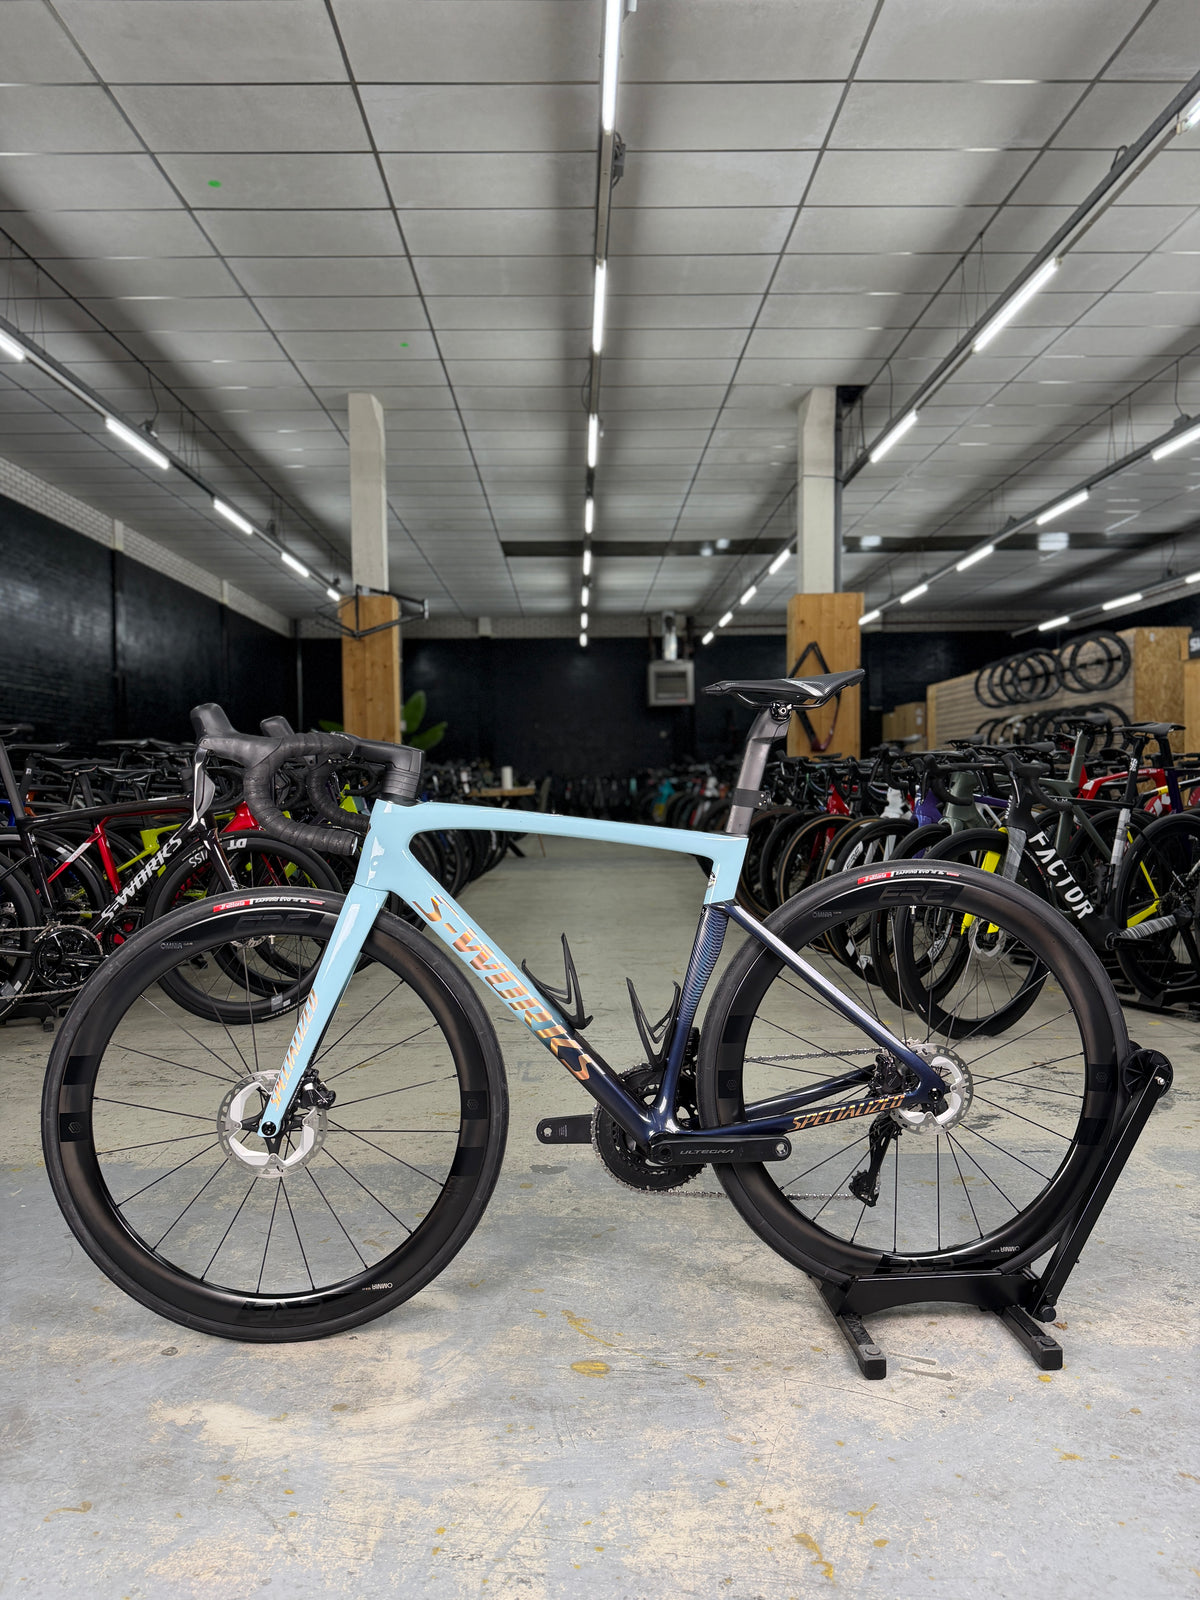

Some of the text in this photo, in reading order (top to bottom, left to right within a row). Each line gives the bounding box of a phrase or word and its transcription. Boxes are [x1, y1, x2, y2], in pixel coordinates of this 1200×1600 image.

[100, 837, 182, 926] S-WORKS
[227, 838, 247, 850] DT
[1028, 831, 1094, 919] FACTOR
[412, 895, 605, 1081] S-WORKS
[790, 1094, 905, 1131] SPECIALIZED
